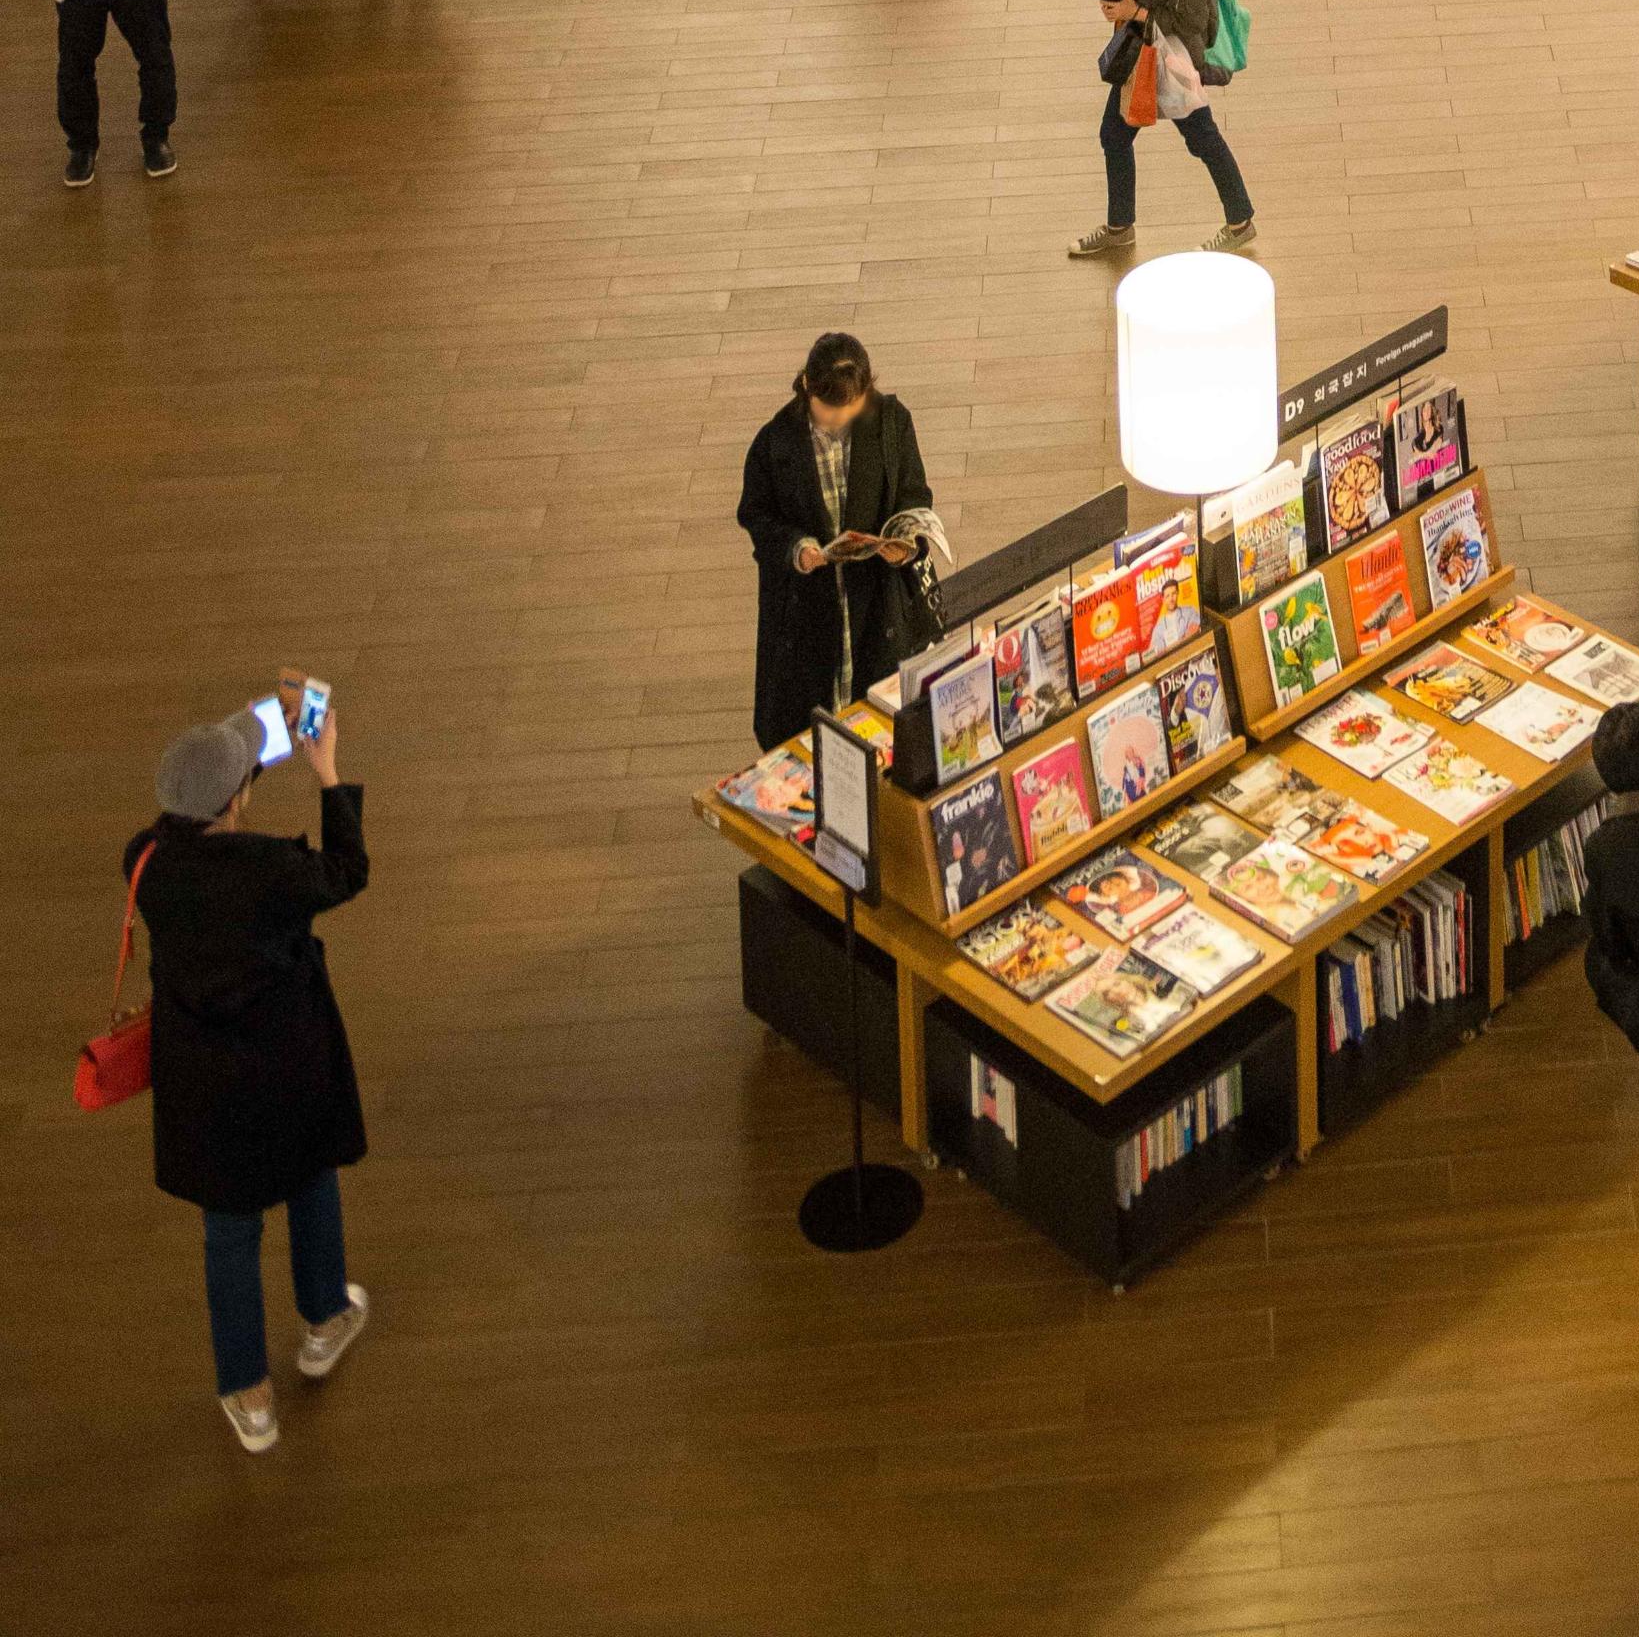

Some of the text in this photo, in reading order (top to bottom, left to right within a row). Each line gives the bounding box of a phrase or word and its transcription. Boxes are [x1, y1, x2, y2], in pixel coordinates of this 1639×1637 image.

[1285, 329, 1434, 422] D9 외국잡지 Foreign magazine
[1424, 509, 1446, 529] FOOD
[1449, 493, 1473, 512] WINE
[997, 636, 1019, 664] O
[1278, 616, 1316, 651] flow
[941, 779, 995, 826] frankie
